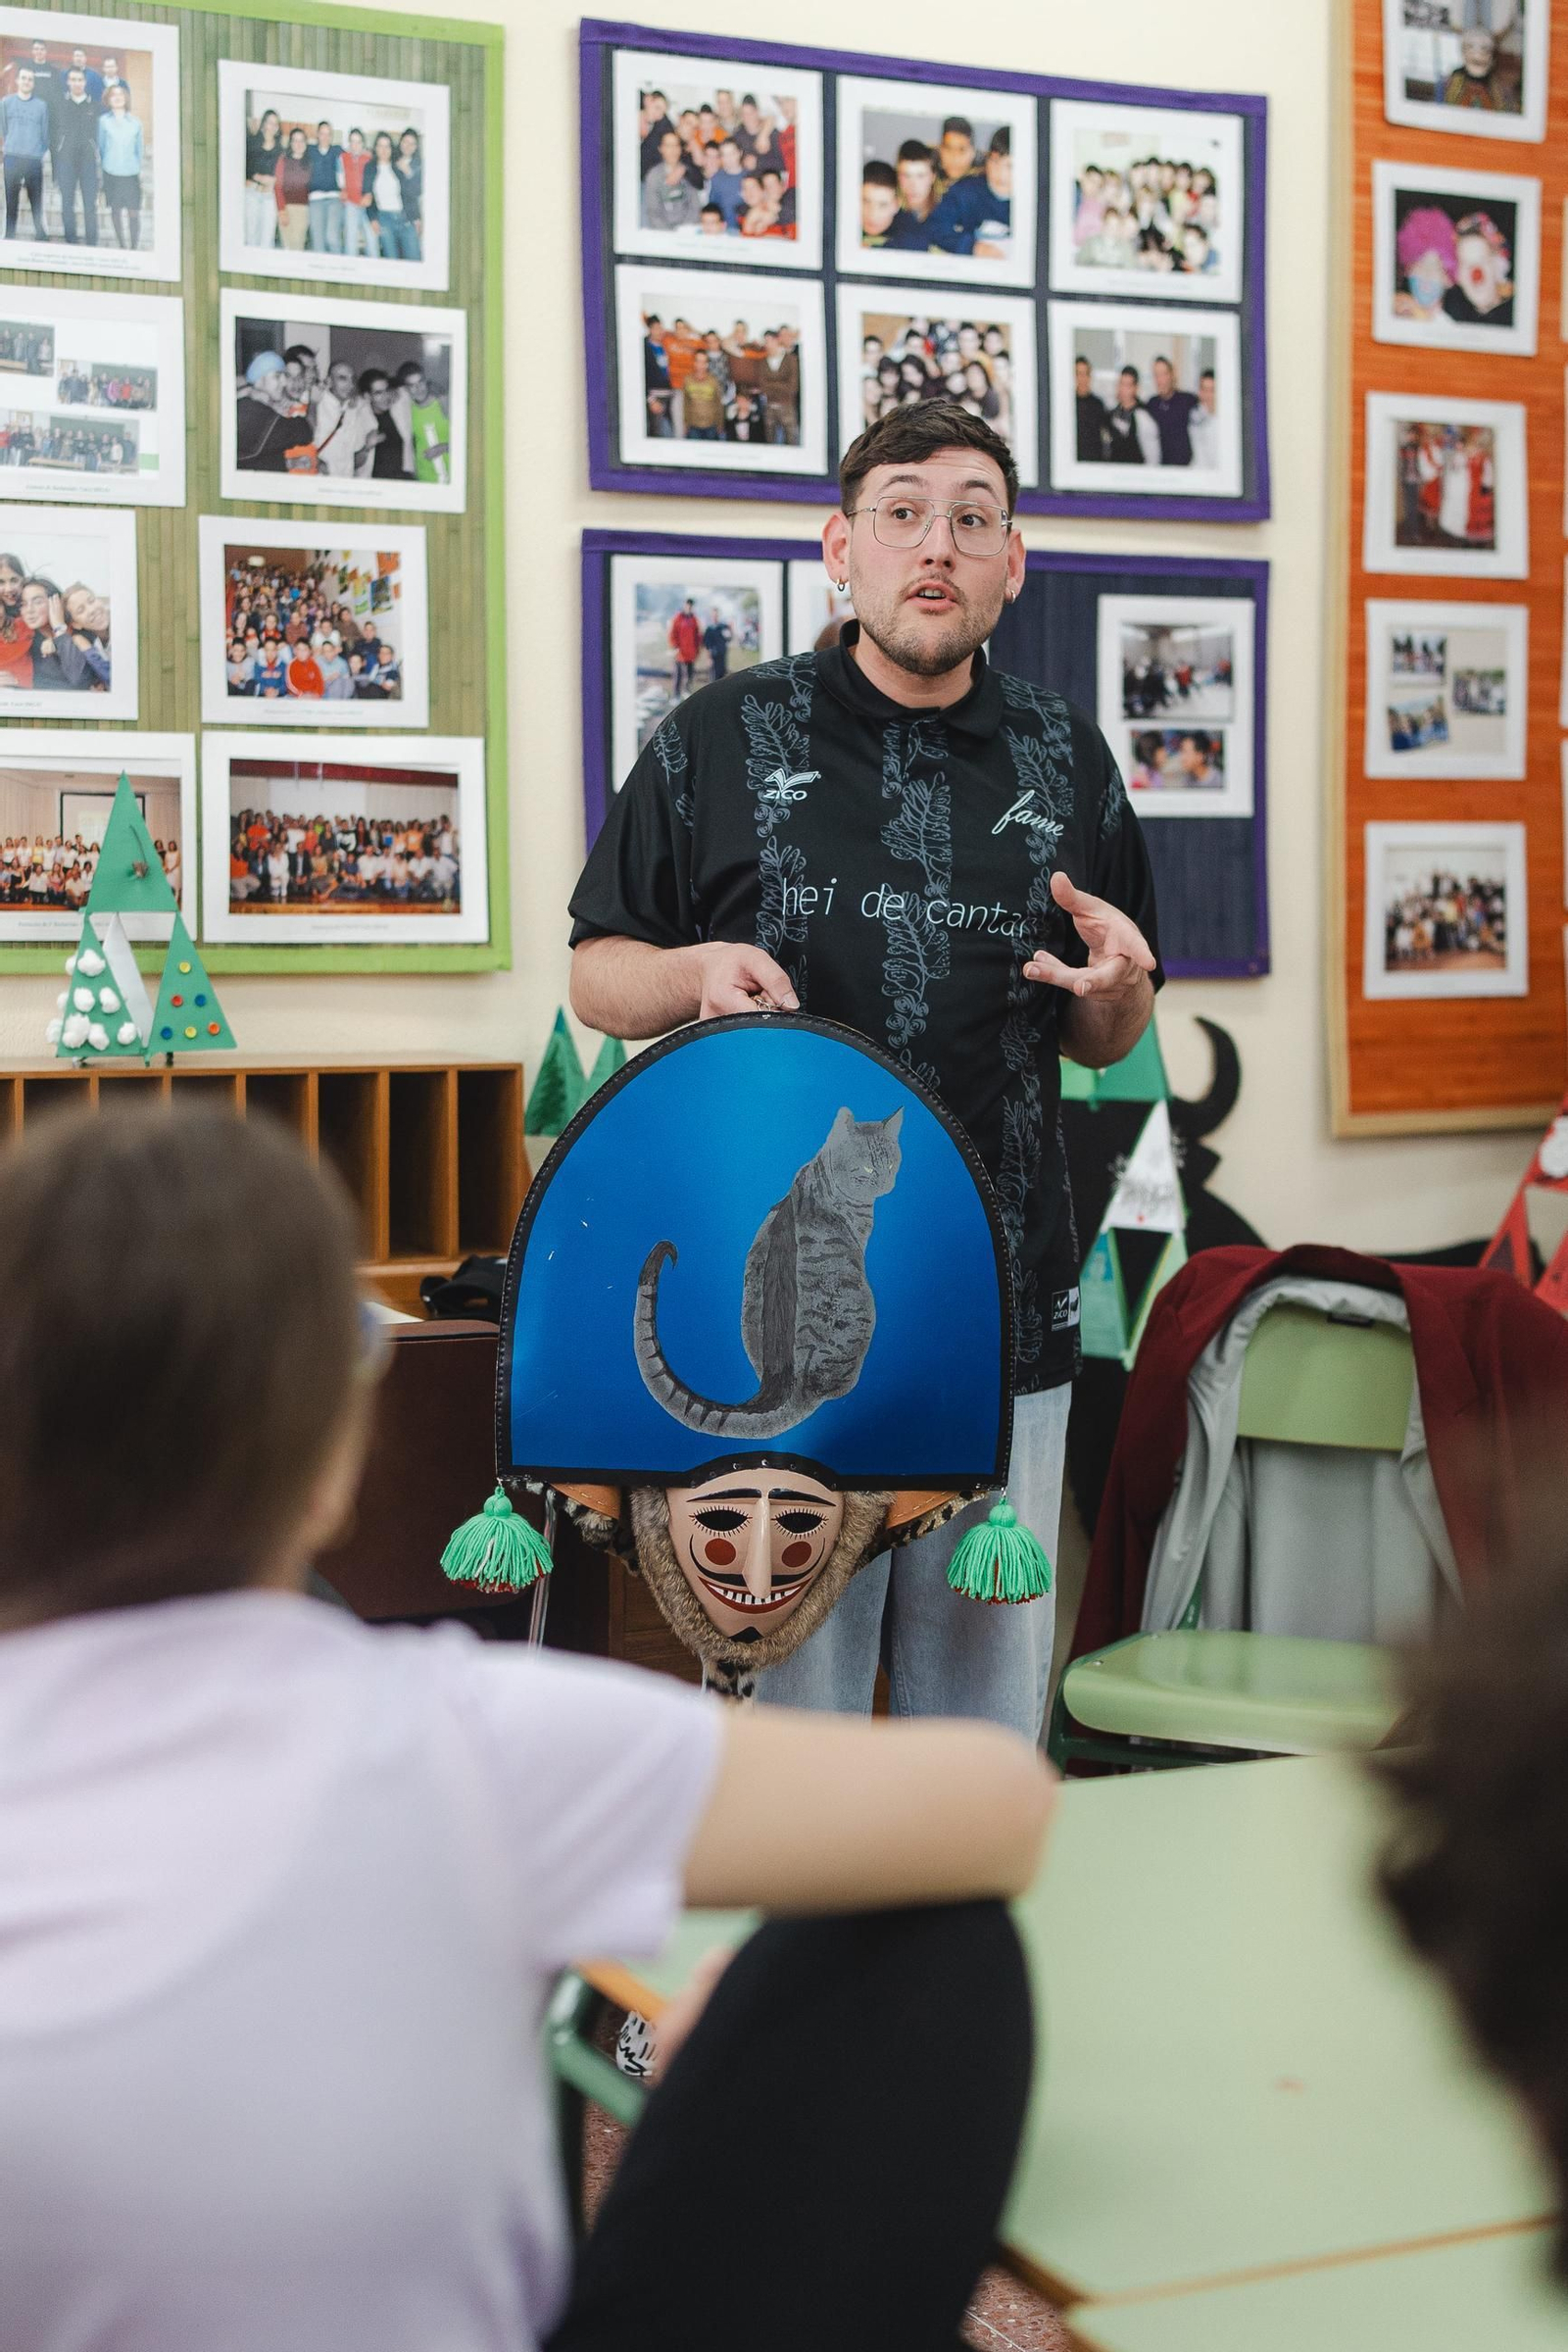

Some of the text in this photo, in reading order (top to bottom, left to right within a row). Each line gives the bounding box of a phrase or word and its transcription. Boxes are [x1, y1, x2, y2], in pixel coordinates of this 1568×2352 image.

[763, 789, 808, 801] ZICO
[992, 789, 1064, 836] fame
[782, 877, 837, 915] hei
[861, 883, 905, 920] de
